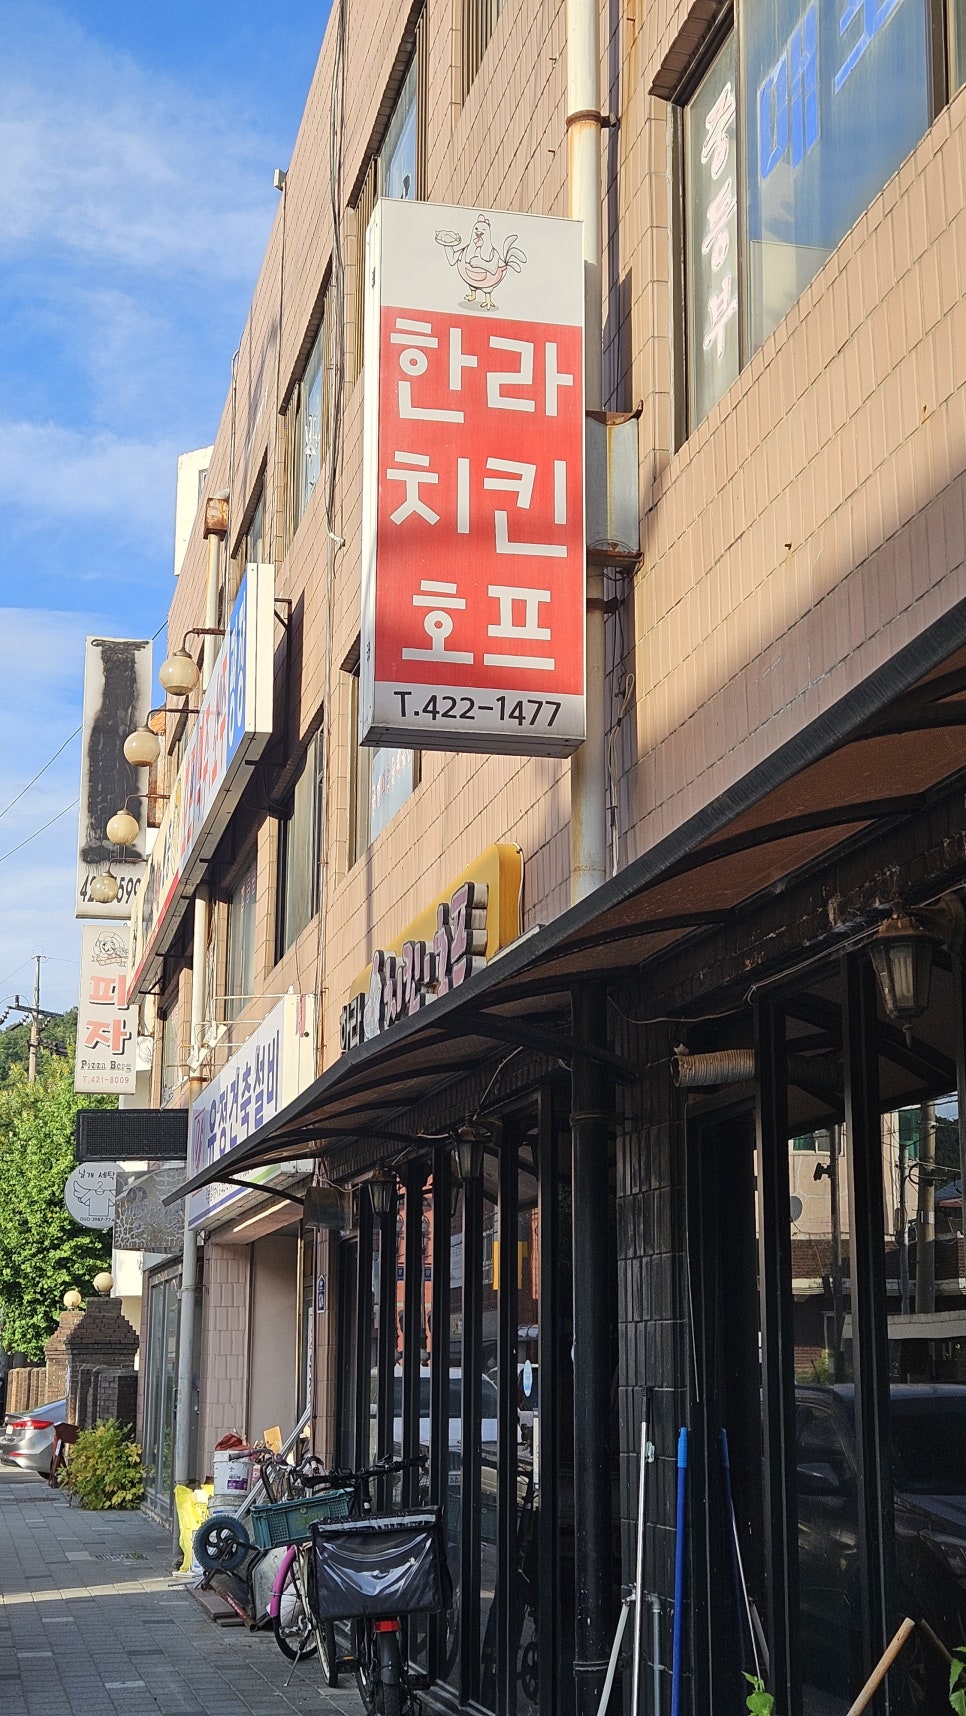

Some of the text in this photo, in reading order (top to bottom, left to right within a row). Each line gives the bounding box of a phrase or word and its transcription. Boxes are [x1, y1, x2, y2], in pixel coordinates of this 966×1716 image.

[389, 317, 574, 423] 한라
[387, 450, 568, 558] 치킨
[401, 579, 556, 671] 호프
[393, 690, 561, 728] T.422-1477
[84, 974, 132, 1055] 피자
[81, 1059, 106, 1070] Pizza
[207, 1029, 280, 1166] 유정건축설비
[78, 1169, 116, 1181] 날개 세탁
